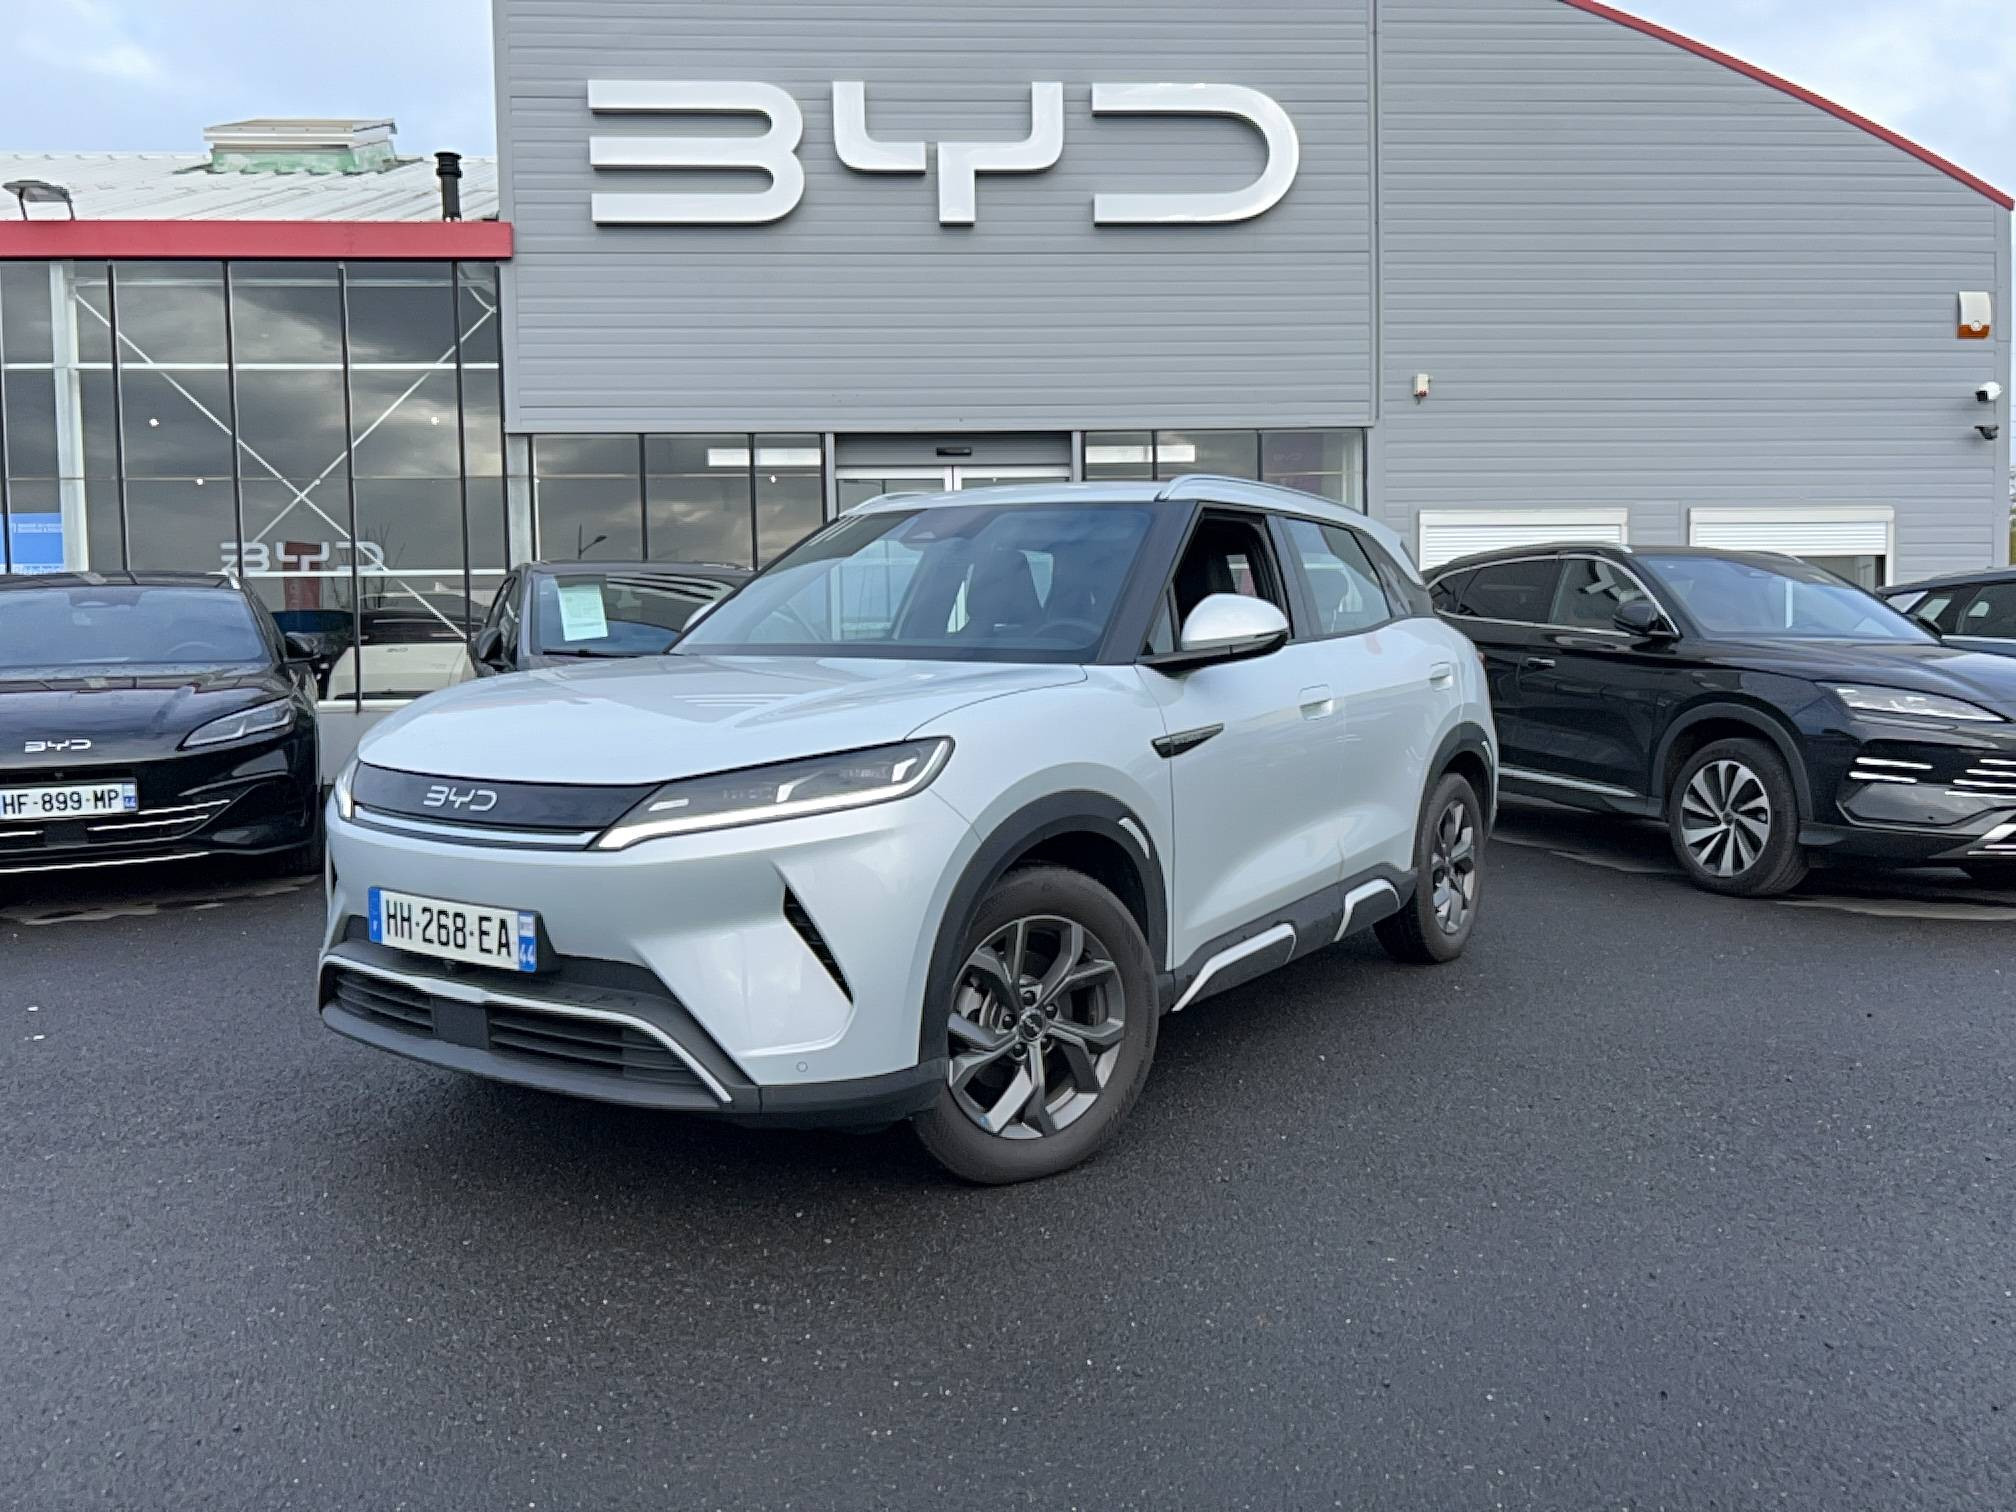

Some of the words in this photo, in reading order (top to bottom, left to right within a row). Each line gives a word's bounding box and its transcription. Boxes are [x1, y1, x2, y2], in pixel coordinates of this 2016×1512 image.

[587, 80, 1300, 226] BYD
[220, 541, 384, 571] BYD
[24, 739, 92, 753] BYD
[2, 789, 119, 814] HF-899-MP
[423, 784, 498, 811] BYD
[386, 899, 512, 958] HH-268-EA
